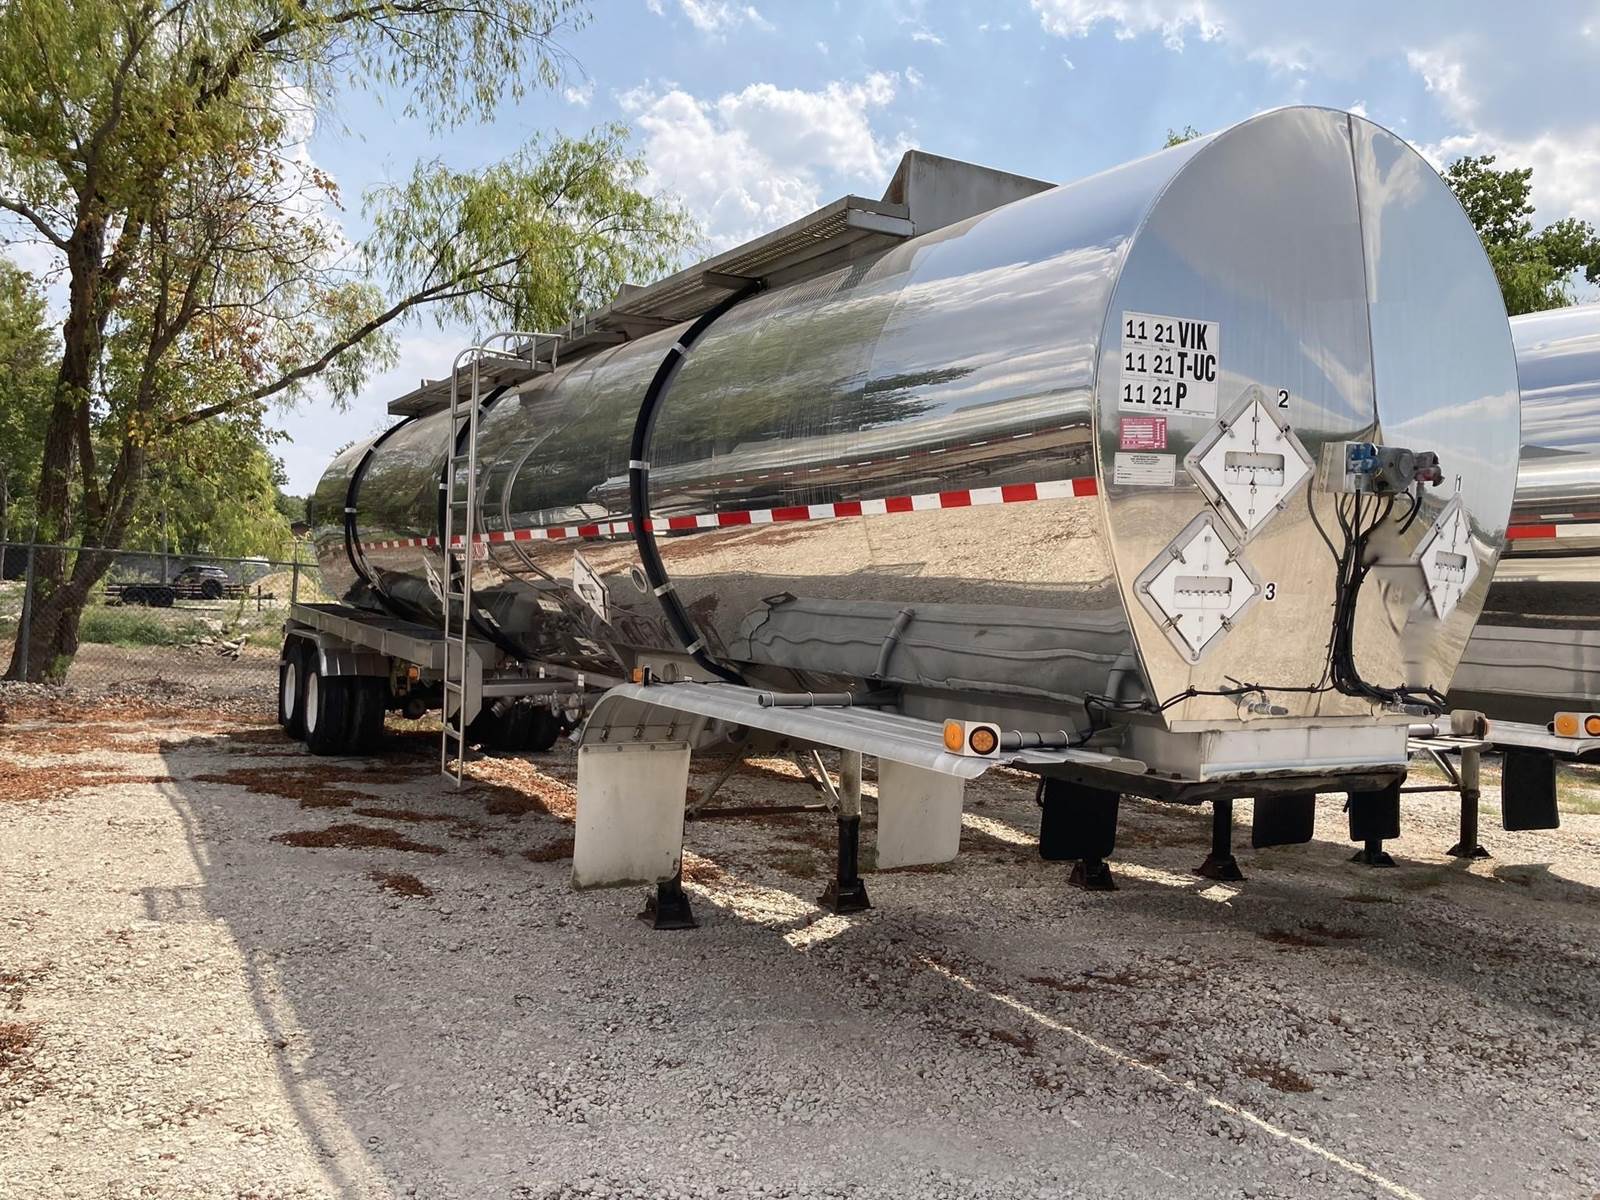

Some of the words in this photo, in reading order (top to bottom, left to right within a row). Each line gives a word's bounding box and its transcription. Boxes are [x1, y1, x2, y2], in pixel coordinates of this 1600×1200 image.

[1126, 320, 1147, 339] 11
[1155, 324, 1175, 343] 21
[1179, 322, 1207, 350] VIK
[1126, 352, 1147, 372] 11
[1154, 355, 1174, 374] 21
[1178, 352, 1215, 382] T-UC
[1124, 384, 1145, 403] 11
[1152, 387, 1172, 405] 21
[1177, 382, 1187, 408] P
[1279, 390, 1288, 408] 2
[1266, 583, 1275, 600] 3
